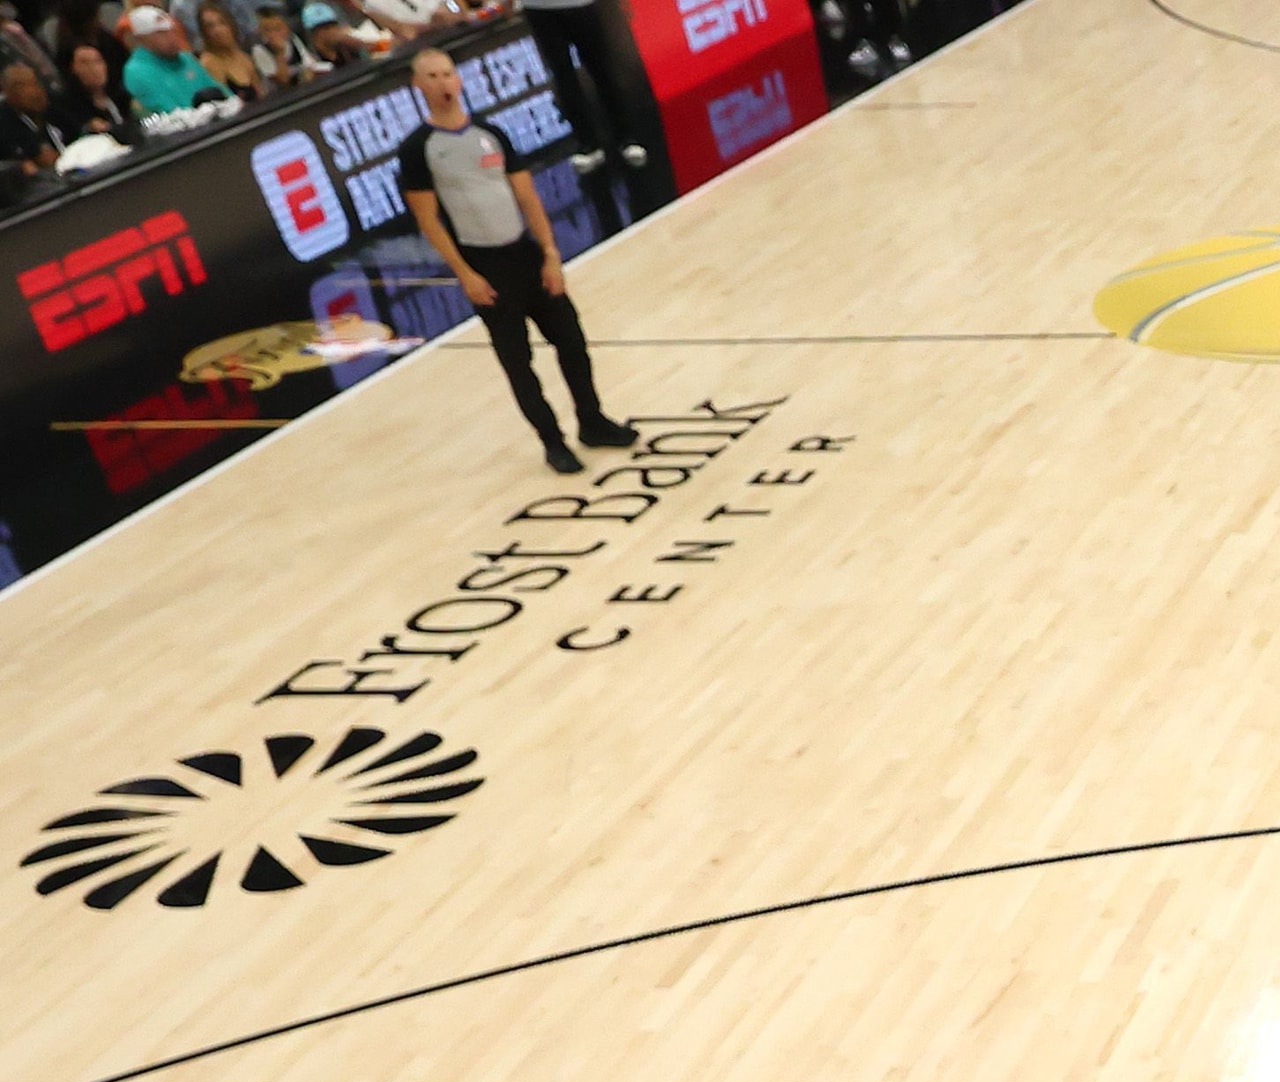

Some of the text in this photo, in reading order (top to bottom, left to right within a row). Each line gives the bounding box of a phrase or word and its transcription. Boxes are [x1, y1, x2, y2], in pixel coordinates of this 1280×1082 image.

[16, 209, 208, 352] ESPN
[254, 395, 791, 705] Frost Bank
[556, 432, 857, 653] CENTER
